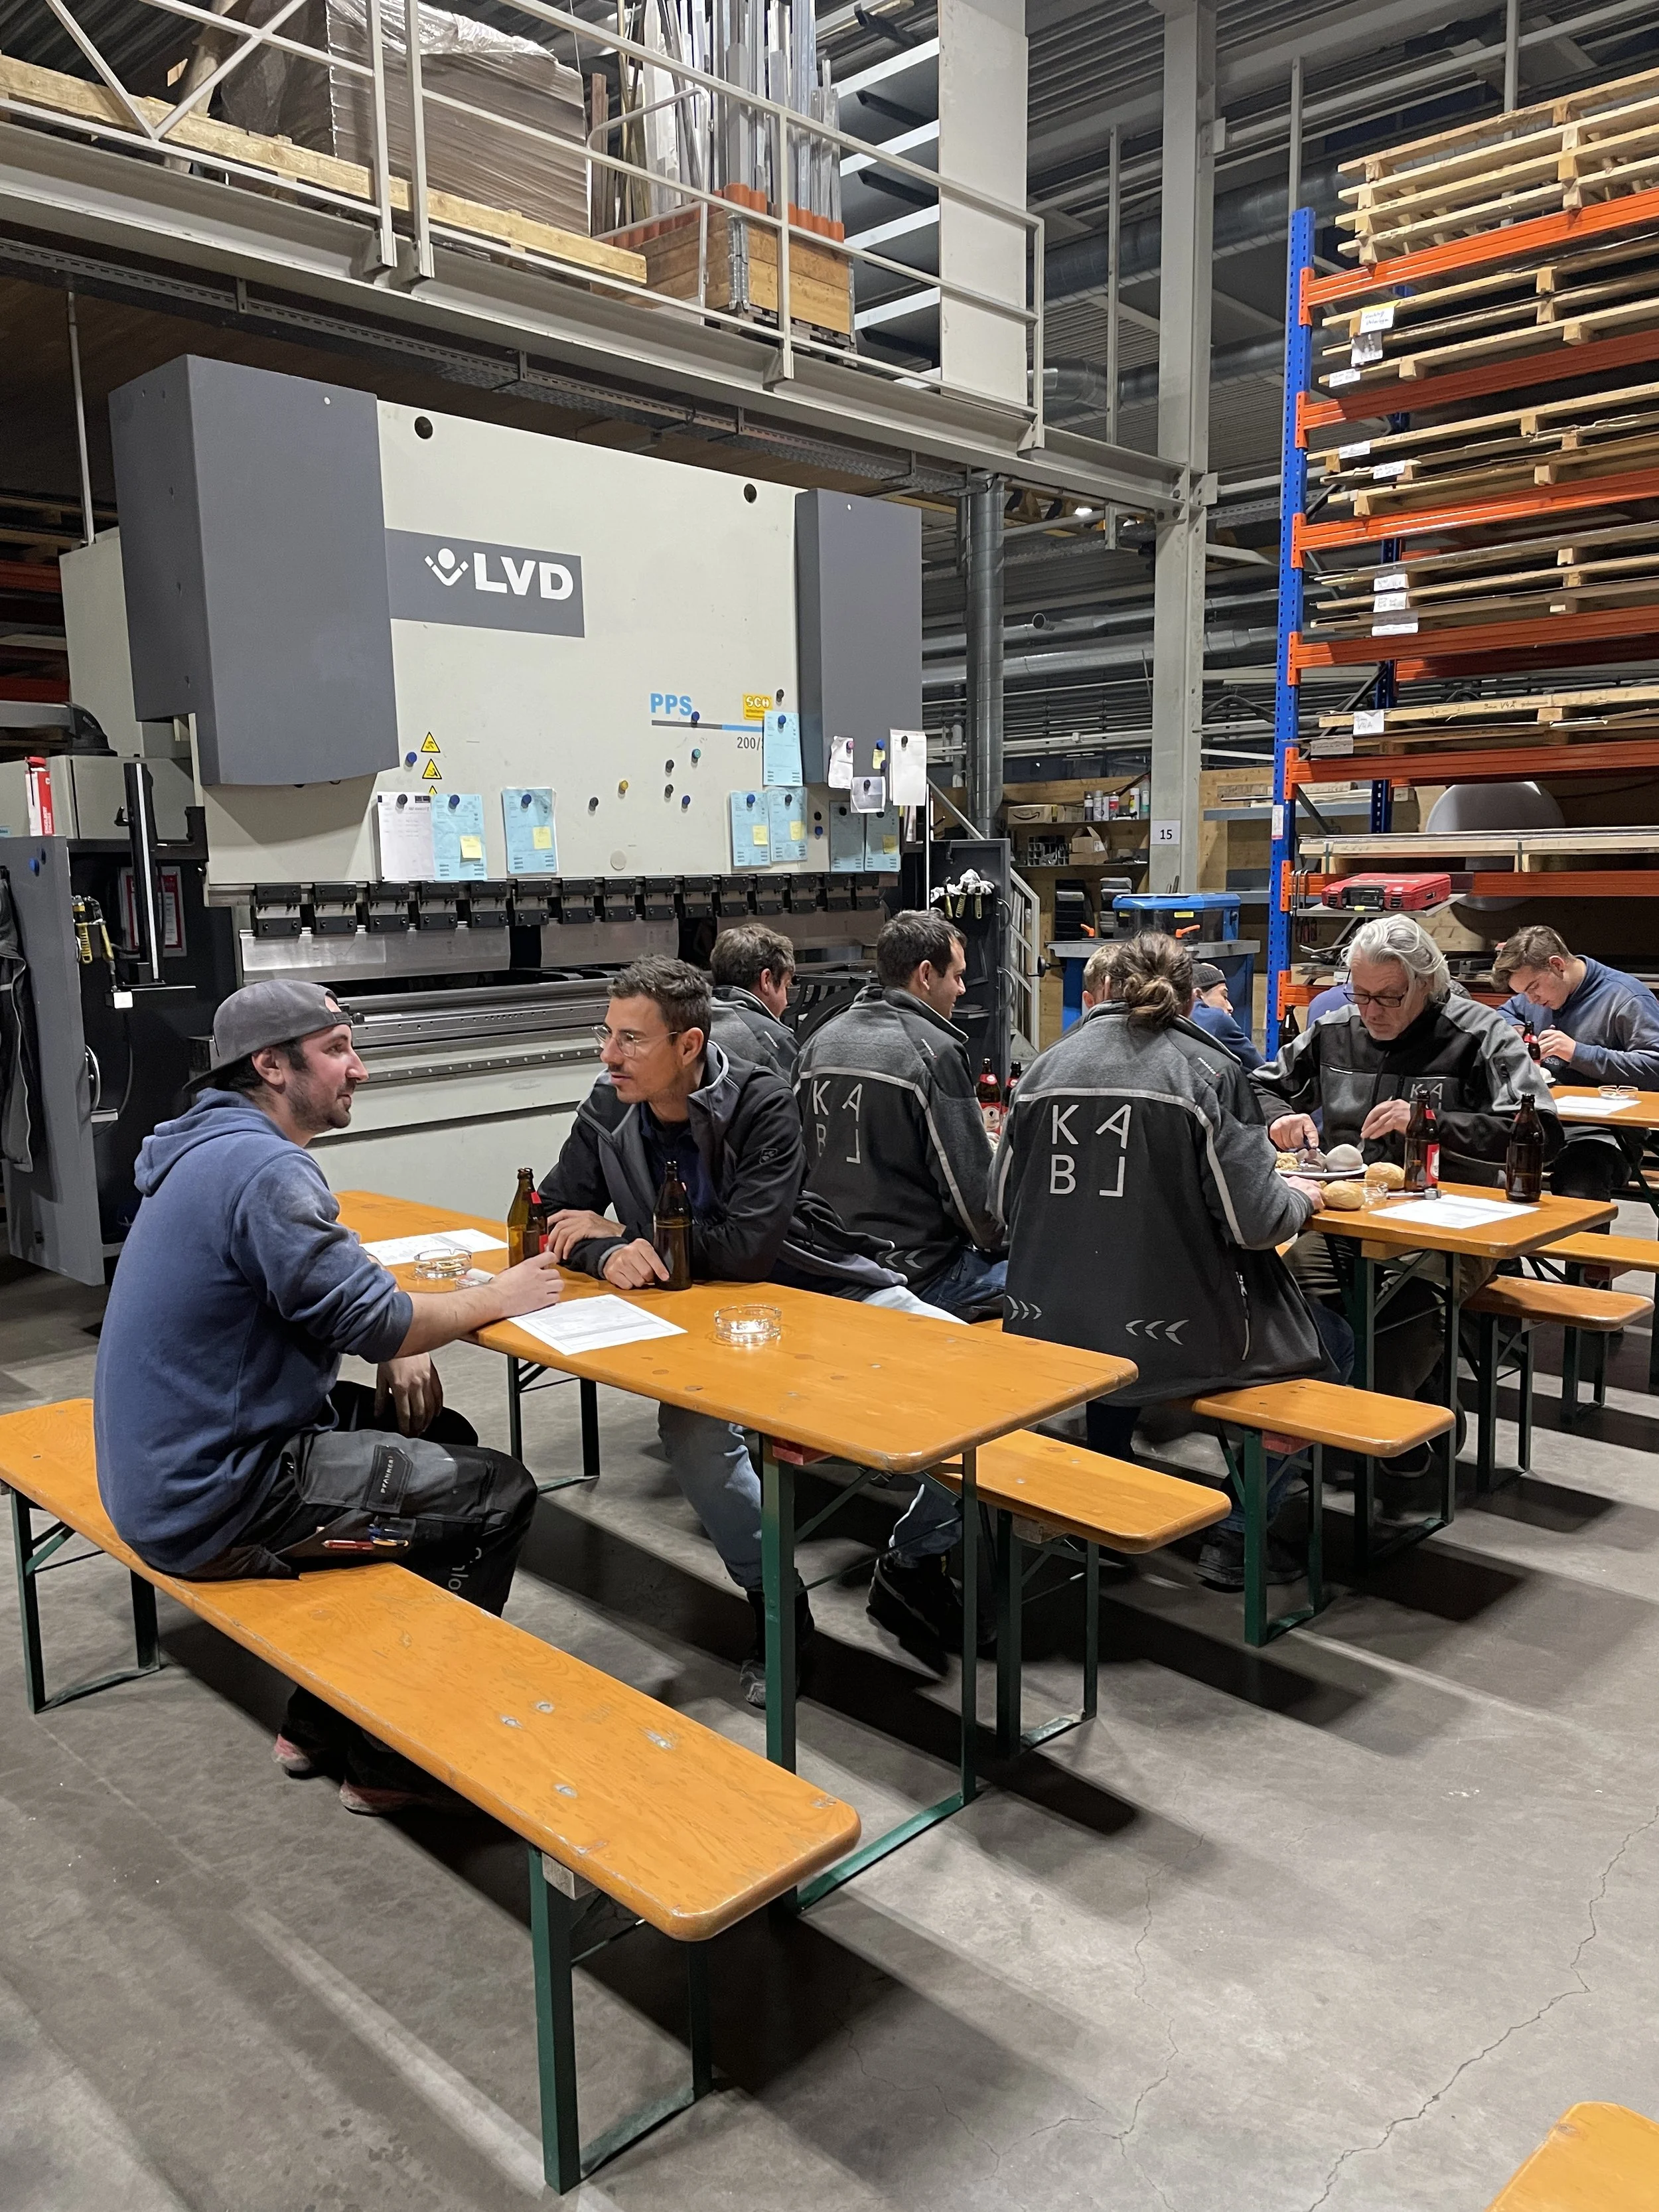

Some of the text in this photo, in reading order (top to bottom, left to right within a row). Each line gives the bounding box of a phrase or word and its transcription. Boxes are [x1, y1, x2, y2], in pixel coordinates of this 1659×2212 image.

[473, 552, 574, 600] LVD
[650, 693, 692, 716] PPS
[745, 696, 770, 708] SCH
[737, 737, 764, 751] 200/
[1160, 829, 1173, 840] 15
[380, 1459, 394, 1493] PFANNER
